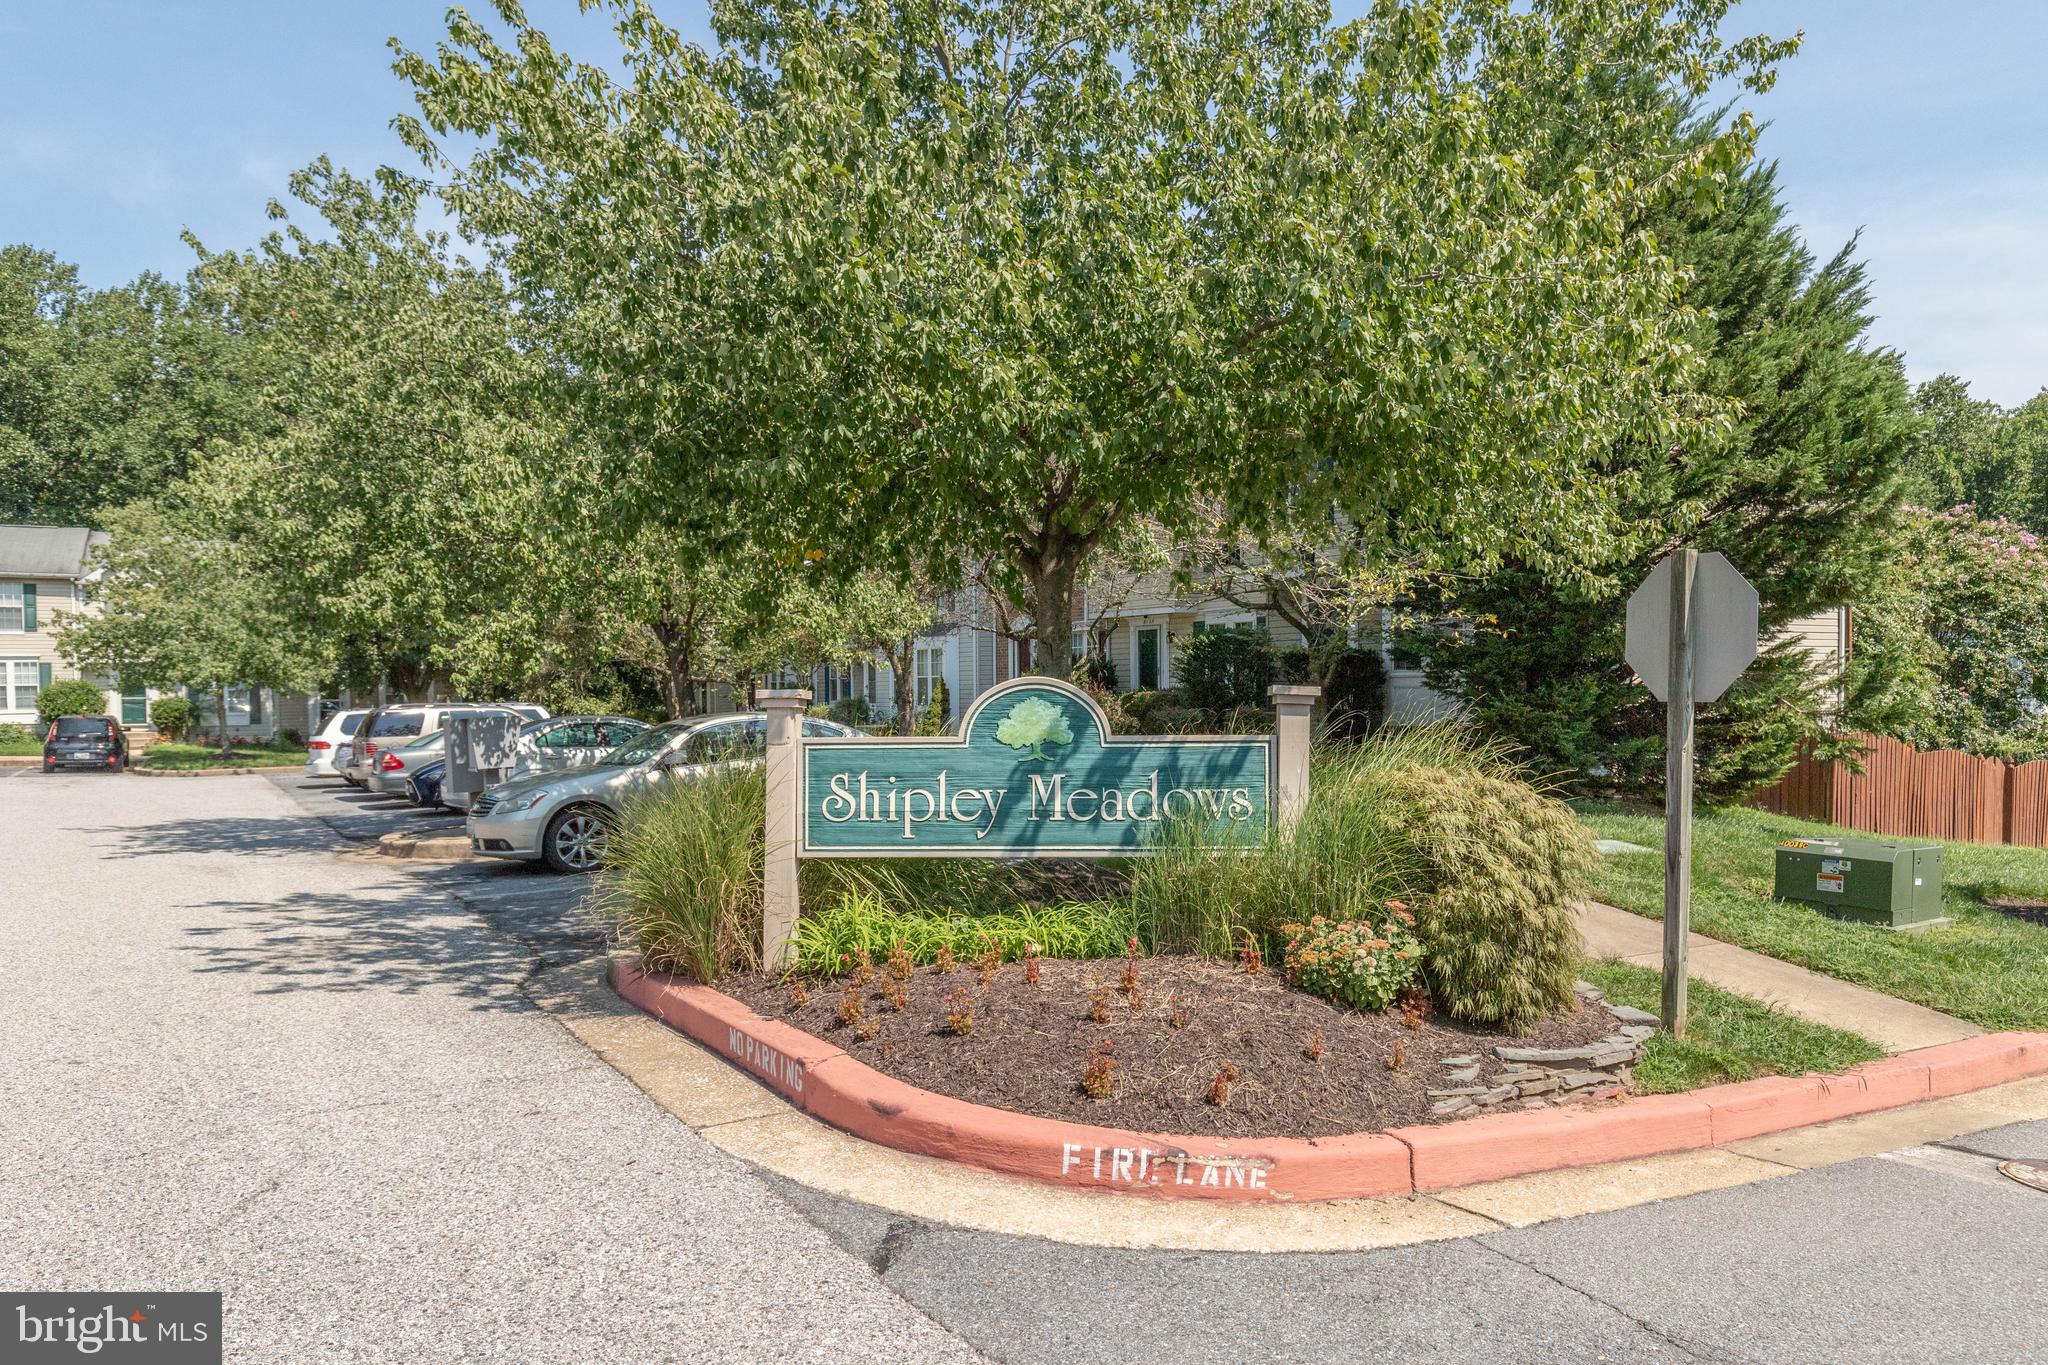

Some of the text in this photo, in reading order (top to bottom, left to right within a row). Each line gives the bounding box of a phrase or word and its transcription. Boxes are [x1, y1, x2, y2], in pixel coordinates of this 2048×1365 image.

[821, 770, 1253, 840] Shipley Meadows
[729, 1026, 803, 1092] NO PARKING
[1176, 1153, 1268, 1190] LANE
